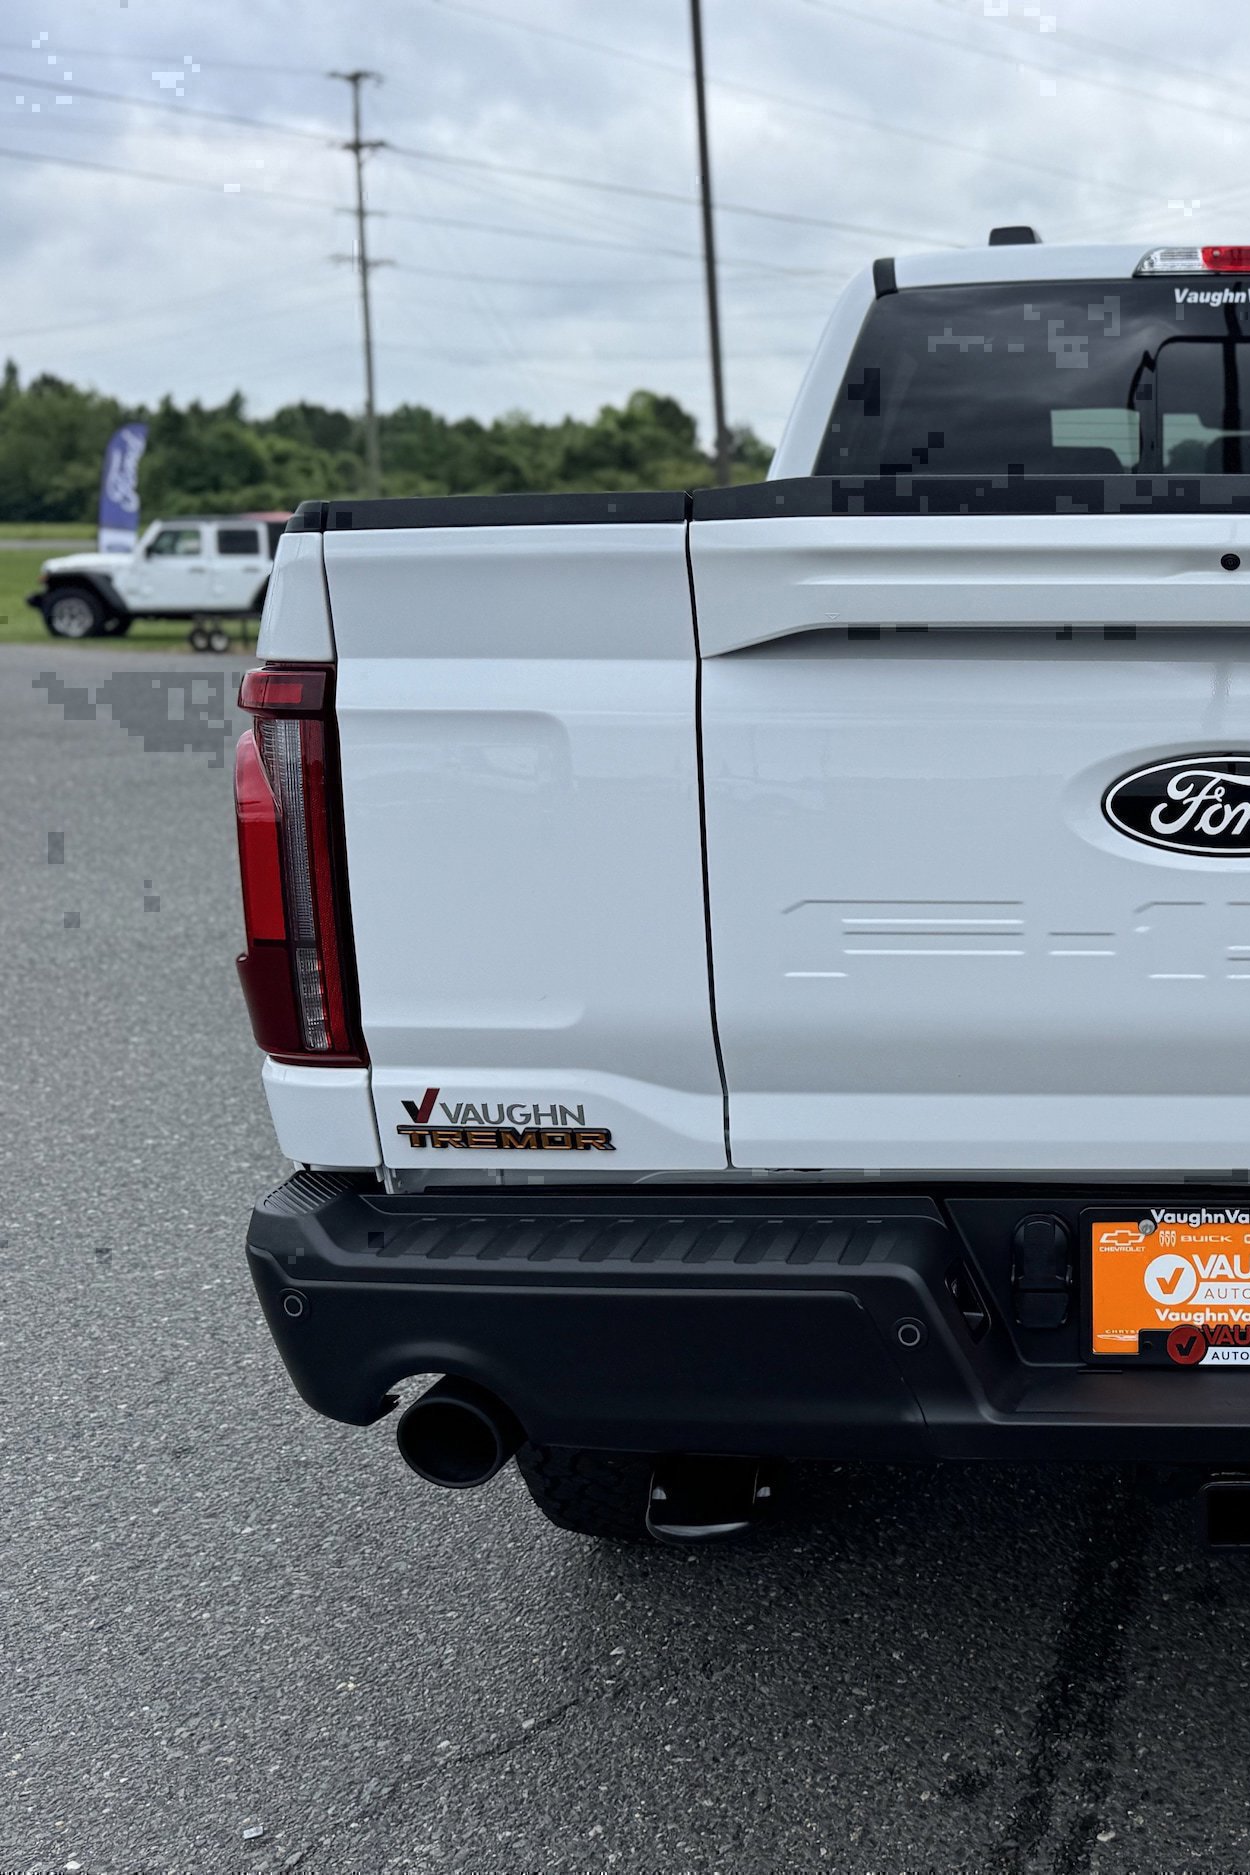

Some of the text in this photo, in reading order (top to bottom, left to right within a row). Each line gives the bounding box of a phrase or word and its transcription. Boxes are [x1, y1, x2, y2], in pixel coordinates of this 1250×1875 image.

[439, 1102, 585, 1125] VAUGHN
[396, 1124, 617, 1150] TREMOR
[1180, 1234, 1233, 1242] BUICK
